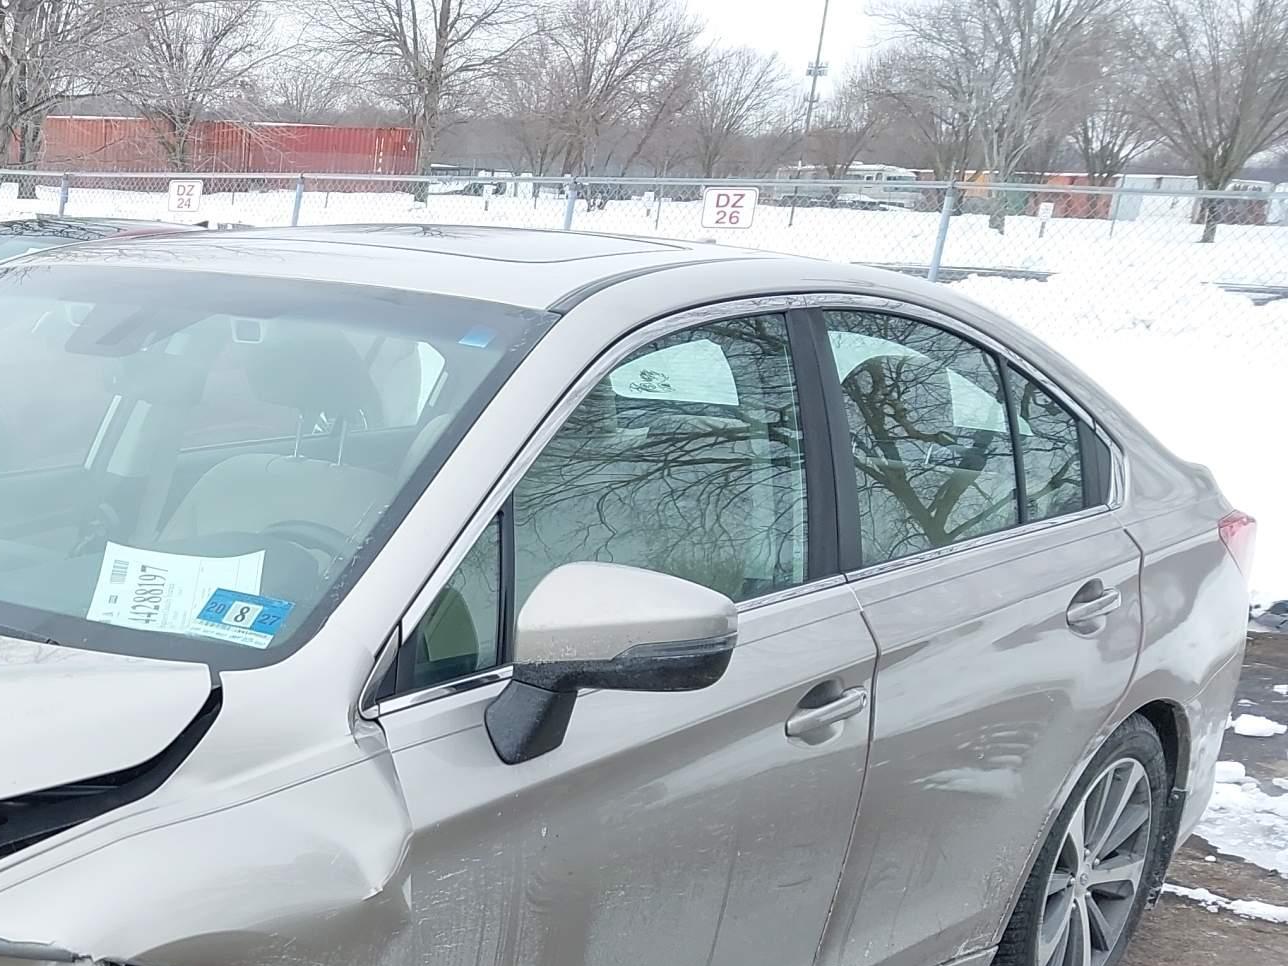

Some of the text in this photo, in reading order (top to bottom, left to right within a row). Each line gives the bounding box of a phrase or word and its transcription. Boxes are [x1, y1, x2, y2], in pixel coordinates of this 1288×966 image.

[176, 184, 195, 196] DZ
[177, 197, 191, 209] 24
[715, 193, 745, 208] DZ
[715, 209, 740, 225] 26
[128, 564, 169, 625] 44288197
[207, 601, 281, 626] 20 8 27
